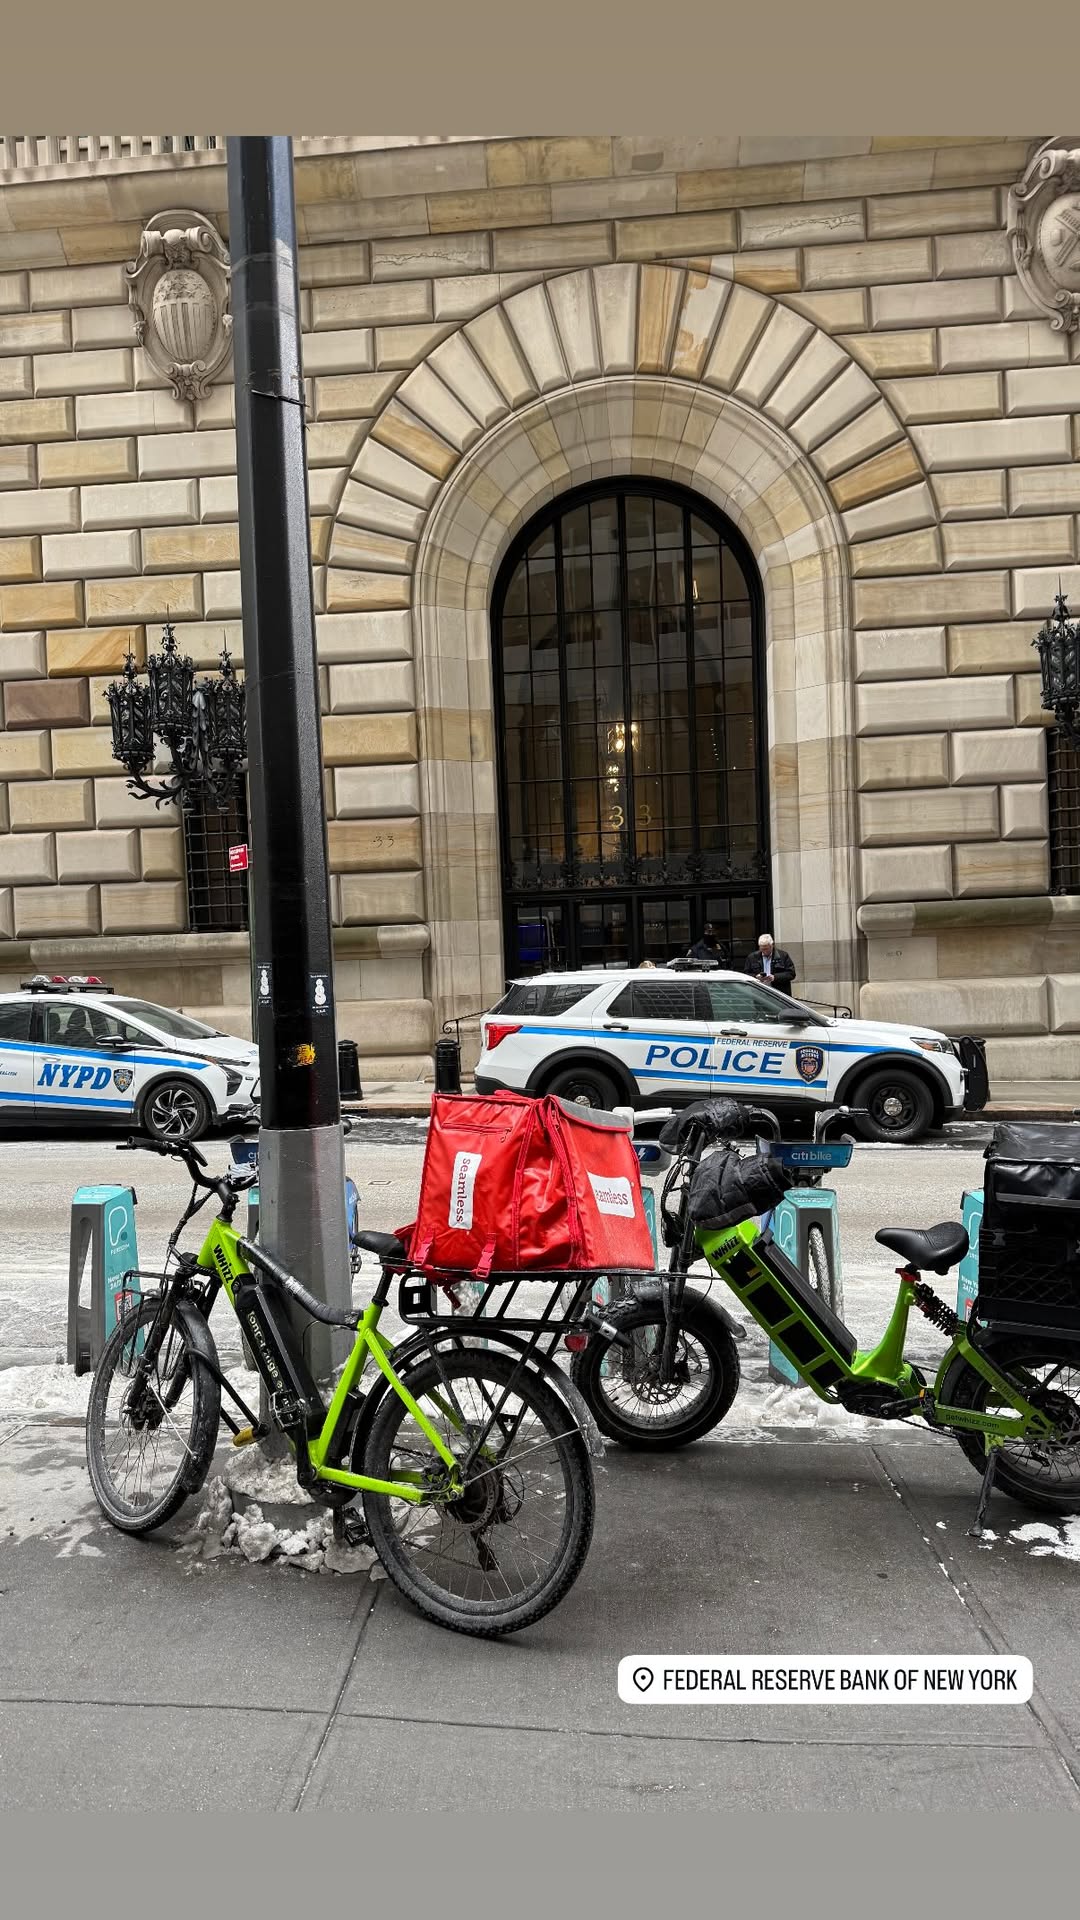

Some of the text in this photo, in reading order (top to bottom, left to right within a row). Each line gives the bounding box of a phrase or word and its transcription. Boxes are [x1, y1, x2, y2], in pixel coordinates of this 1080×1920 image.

[716, 1038, 788, 1049] FEDERAL RESERVE
[645, 1045, 786, 1075] POLICE
[37, 1063, 112, 1090] NYPD
[456, 1157, 471, 1223] seamless
